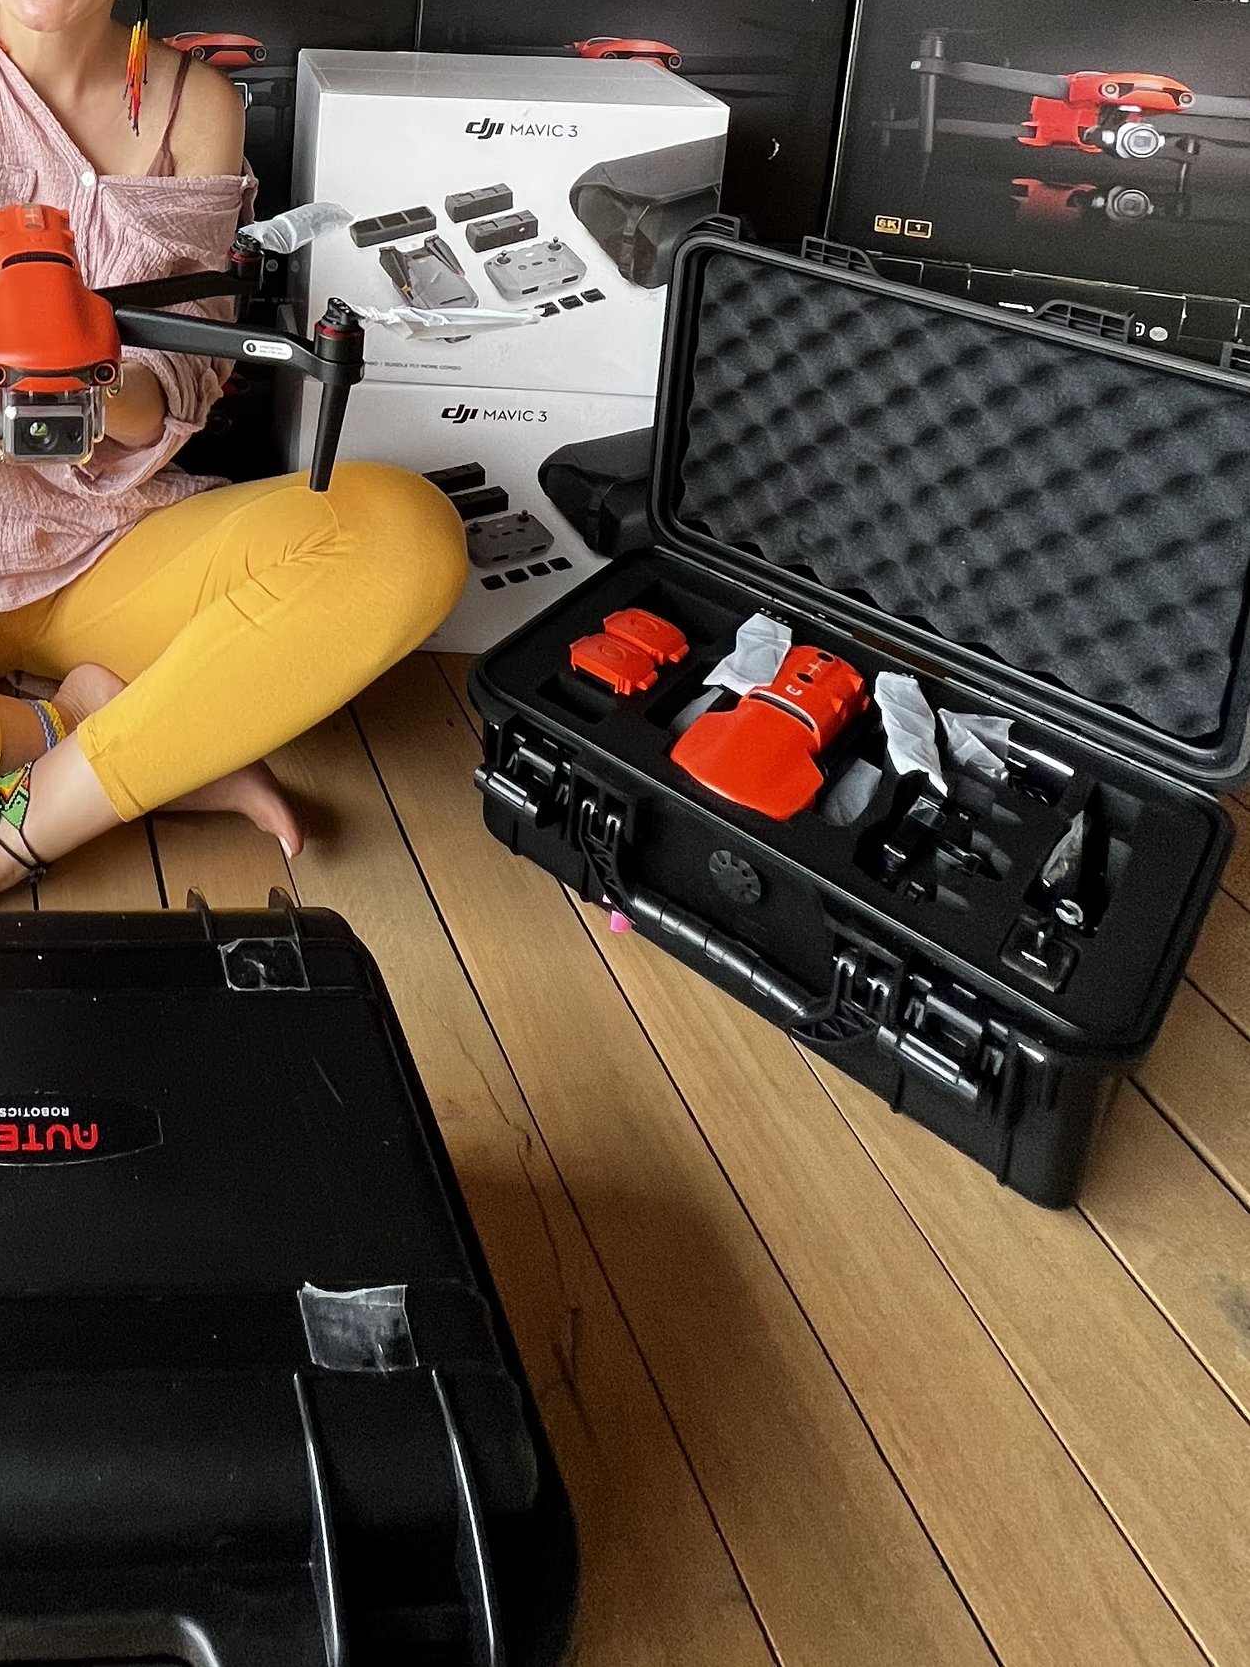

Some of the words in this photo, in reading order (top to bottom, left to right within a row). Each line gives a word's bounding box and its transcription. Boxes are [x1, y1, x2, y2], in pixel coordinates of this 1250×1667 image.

[510, 124, 564, 137] MAVIC
[568, 125, 578, 137] 3
[483, 409, 534, 422] MAVIC
[538, 410, 548, 423] 3
